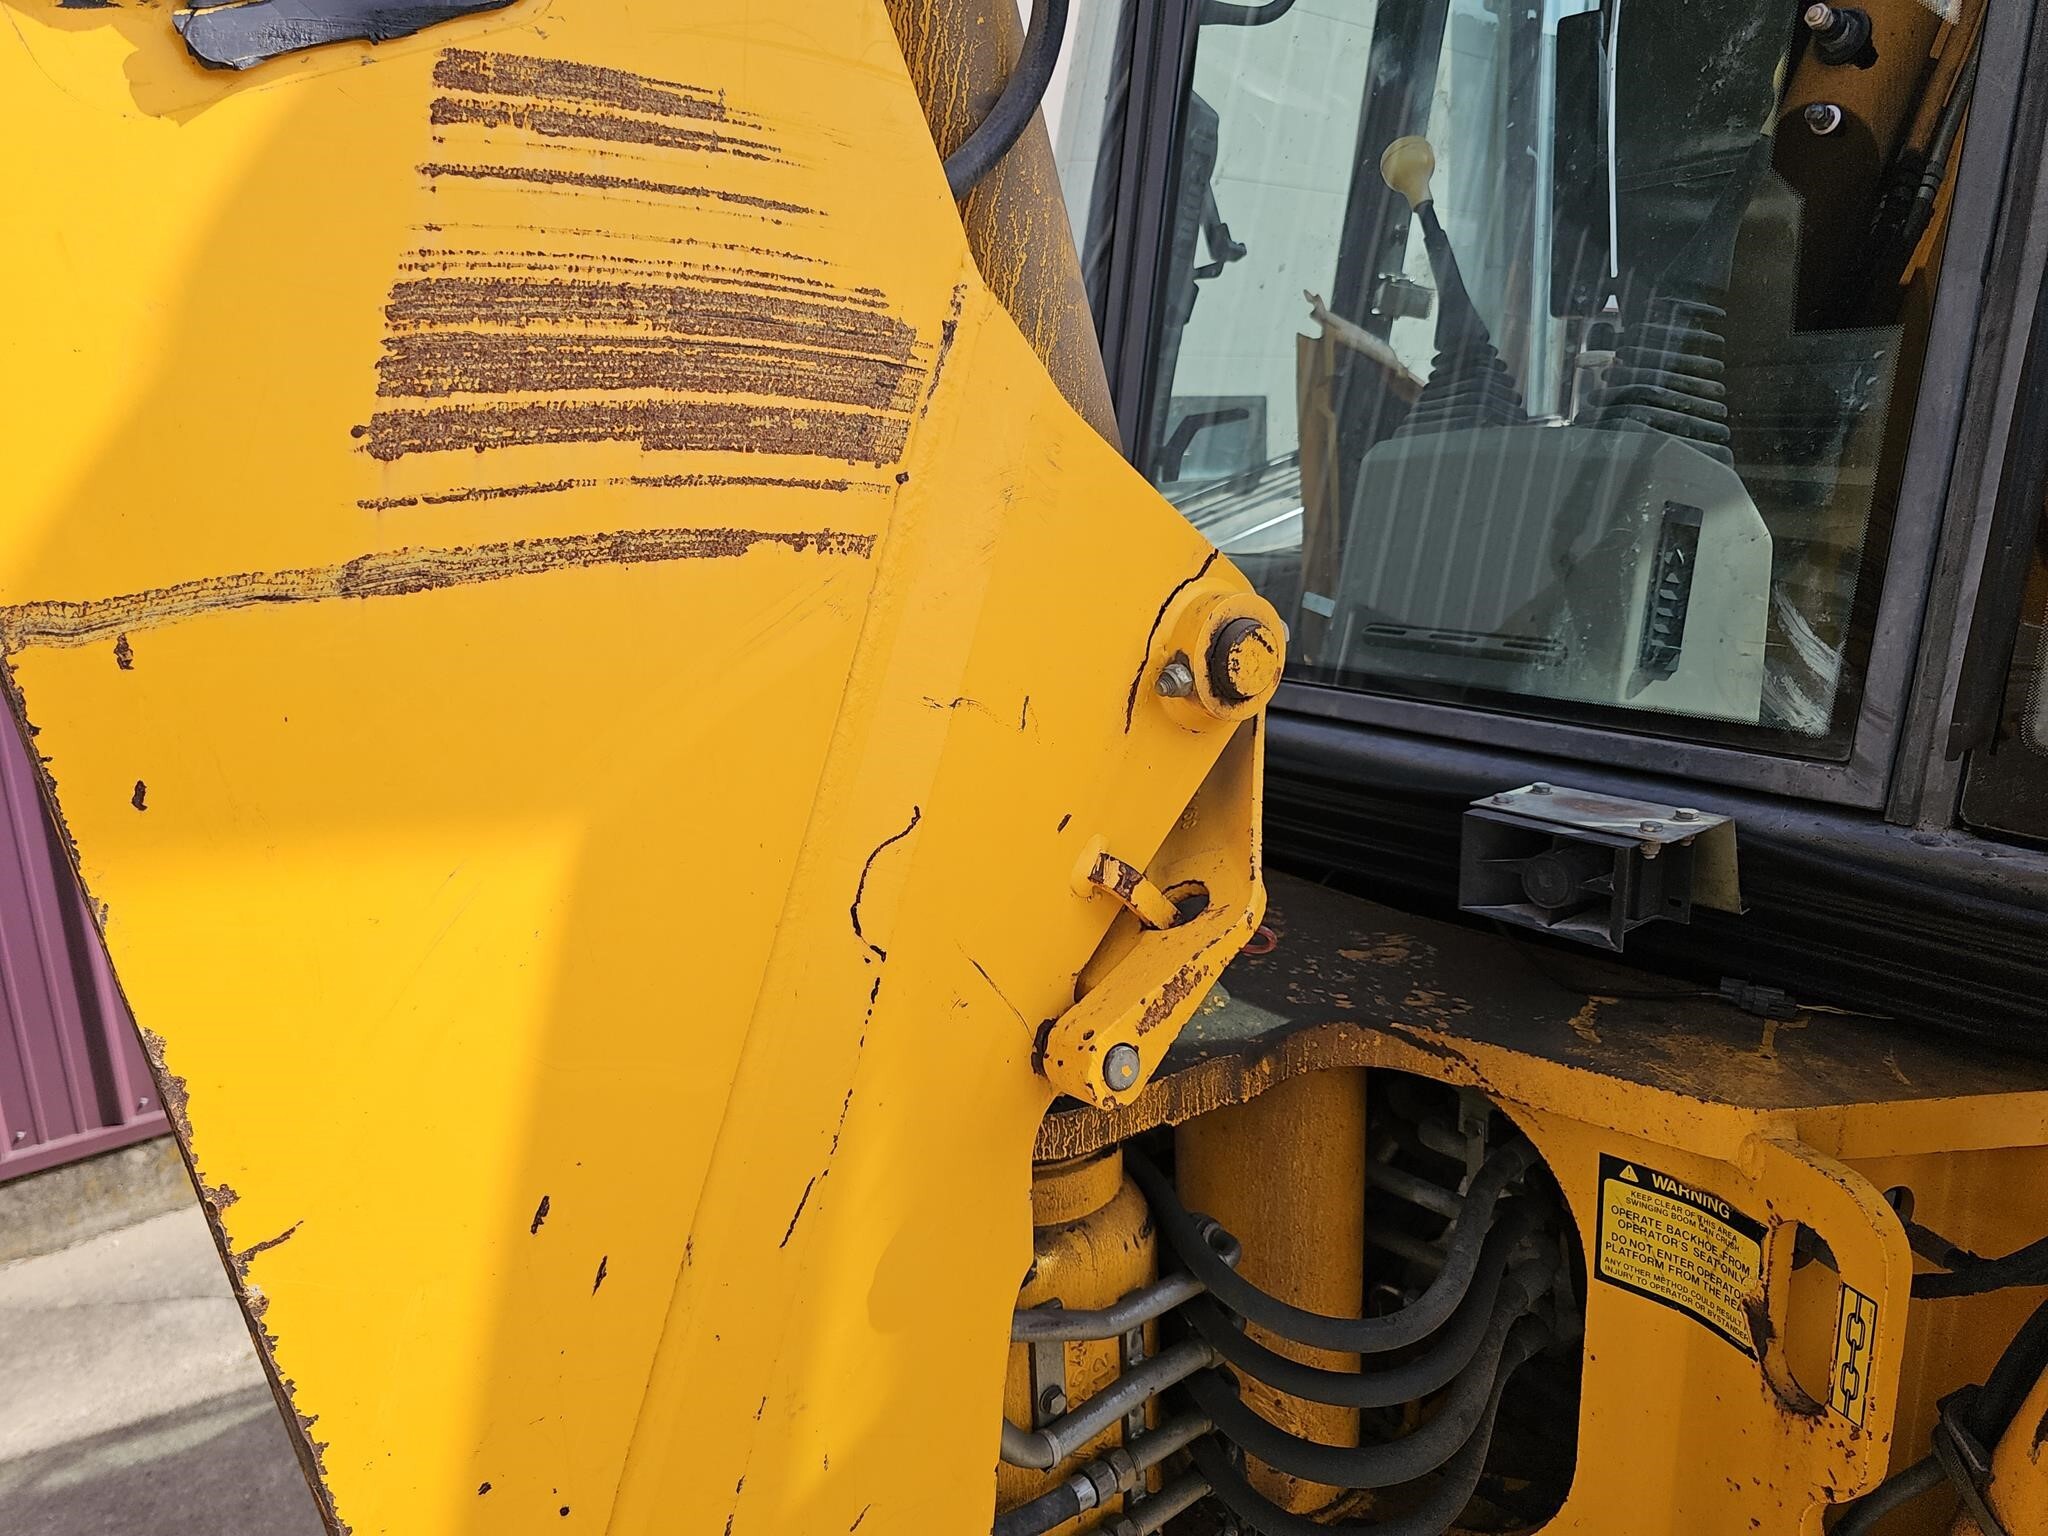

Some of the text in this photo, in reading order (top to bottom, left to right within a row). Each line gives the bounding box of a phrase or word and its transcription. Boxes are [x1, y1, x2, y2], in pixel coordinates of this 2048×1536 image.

[1626, 1197, 1668, 1217] SWINGING
[1671, 1213, 1696, 1227] BOOM
[1698, 1224, 1714, 1238] CAN
[1631, 1190, 1737, 1242] KEEP CLEAR OF THIS AREA
[1652, 1173, 1731, 1219] WARNING
[1611, 1205, 1750, 1276] OPERATE BACKHOE FROM
[1611, 1232, 1627, 1245] DO
[1630, 1239, 1653, 1254] NOT
[1657, 1248, 1695, 1271] ENTER
[1618, 1219, 1688, 1252] OPERATOR'S
[1693, 1247, 1719, 1268] SEAT
[1604, 1265, 1634, 1281] INJURY
[1636, 1276, 1648, 1286] TO
[1650, 1281, 1693, 1305] OPERATOR
[1696, 1301, 1706, 1313] OR
[1604, 1257, 1621, 1267] ANY
[1623, 1263, 1651, 1279] OTHER
[1654, 1274, 1689, 1294] METHOD
[1691, 1290, 1715, 1310] COULD
[1716, 1305, 1742, 1328] RESULT
[1606, 1241, 1664, 1270] PLATFORM
[1668, 1264, 1700, 1286] FROM
[1703, 1280, 1721, 1300] THE
